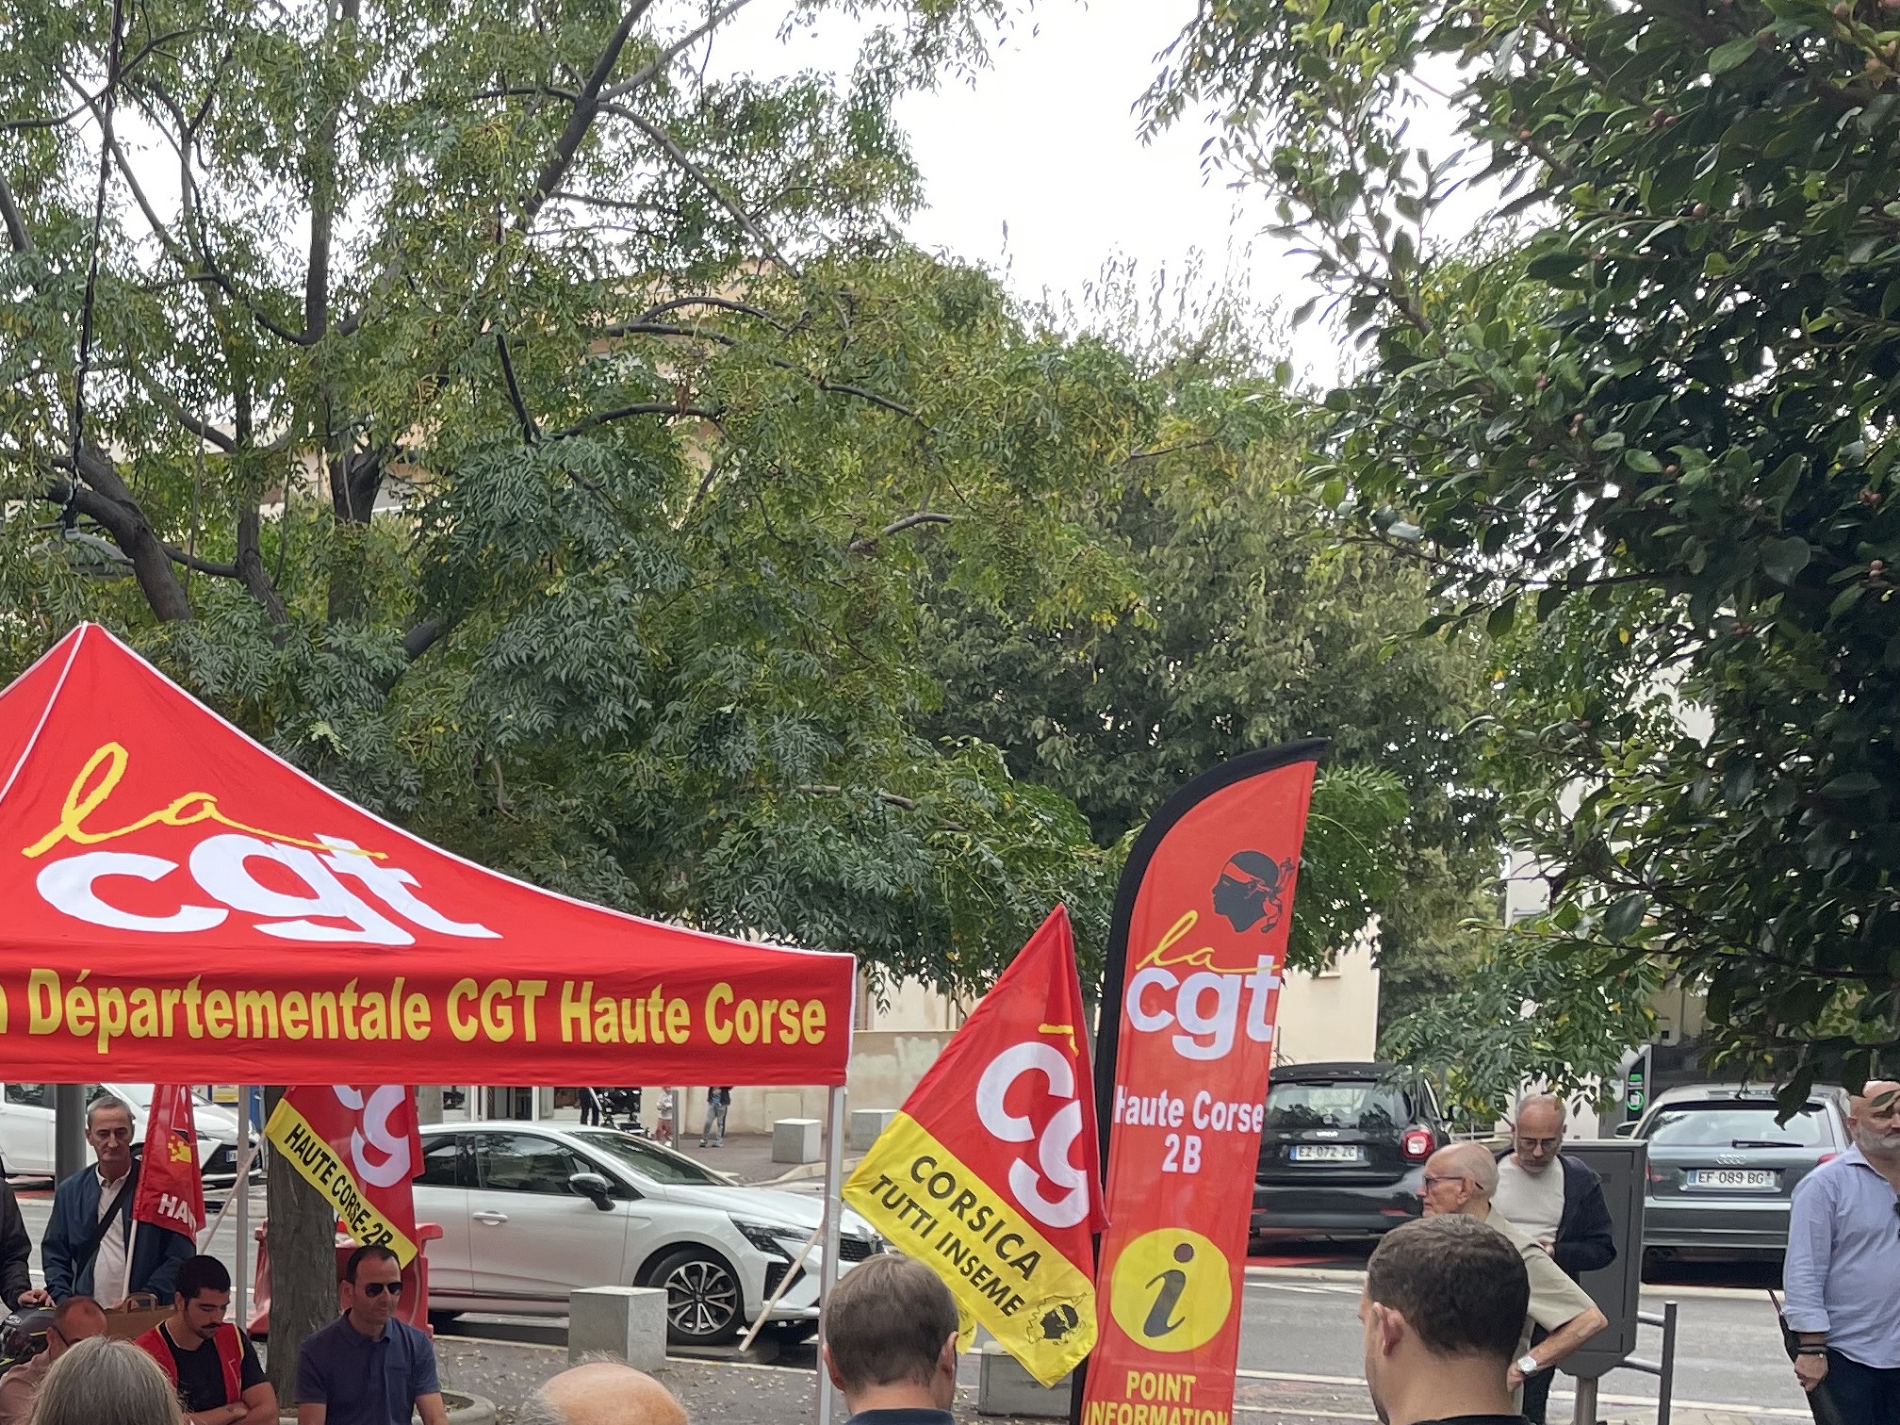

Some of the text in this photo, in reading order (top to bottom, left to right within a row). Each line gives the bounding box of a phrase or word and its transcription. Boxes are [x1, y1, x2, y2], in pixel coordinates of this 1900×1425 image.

[21, 742, 388, 858] la
[36, 833, 505, 946] cgt
[1135, 909, 1281, 971] la
[28, 967, 432, 1054] Départementale
[447, 977, 549, 1043] CGT
[560, 980, 692, 1045] Haute
[704, 982, 827, 1045] Corse
[1126, 954, 1281, 1060] cgt
[283, 1122, 338, 1186] HAUTE
[1162, 1133, 1203, 1174] 2B
[1192, 1090, 1264, 1133] Corse
[868, 1173, 1025, 1318] TUTTI INSEME
[910, 1155, 1042, 1281] CORSICA
[1125, 1370, 1197, 1404] POINT
